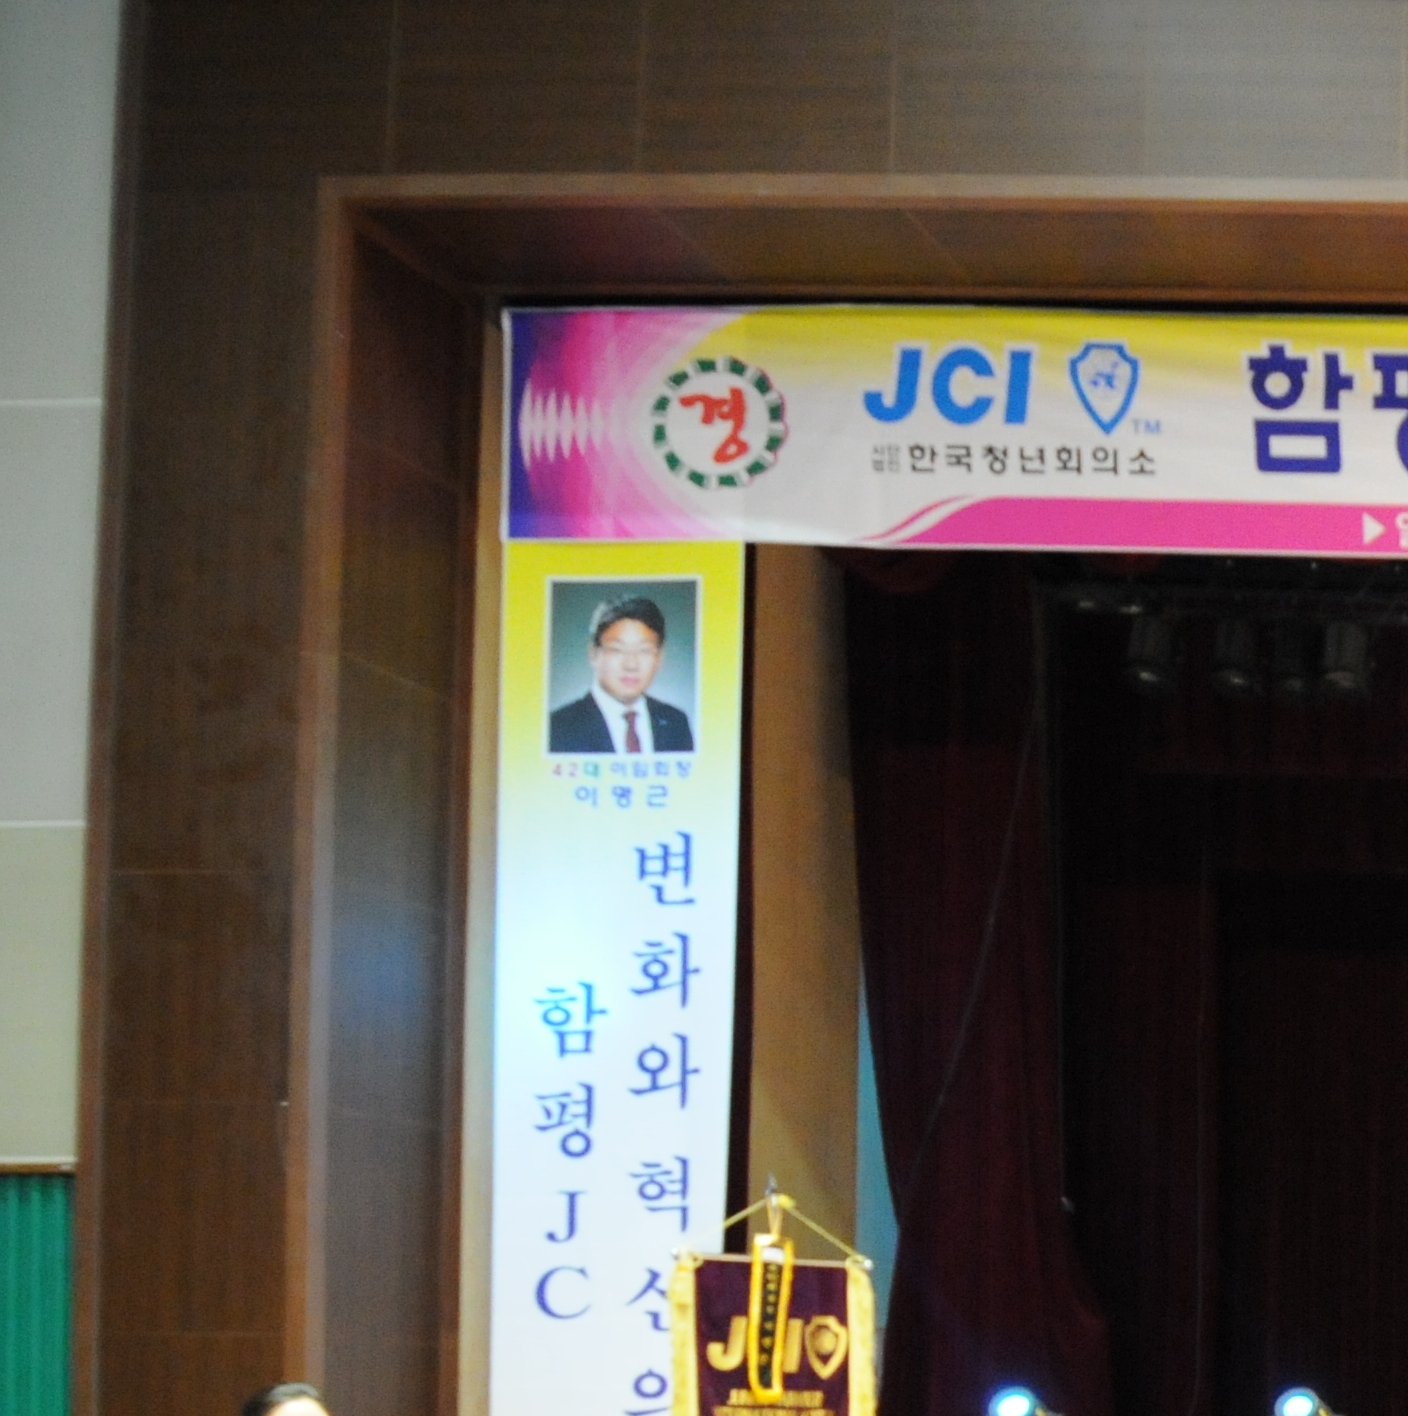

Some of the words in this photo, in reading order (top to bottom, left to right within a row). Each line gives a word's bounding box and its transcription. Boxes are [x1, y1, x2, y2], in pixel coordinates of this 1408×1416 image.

[863, 346, 1033, 425] JCI
[678, 386, 748, 464] 경
[908, 444, 1156, 476] 한국청년회의소
[628, 829, 702, 1110] 변화와
